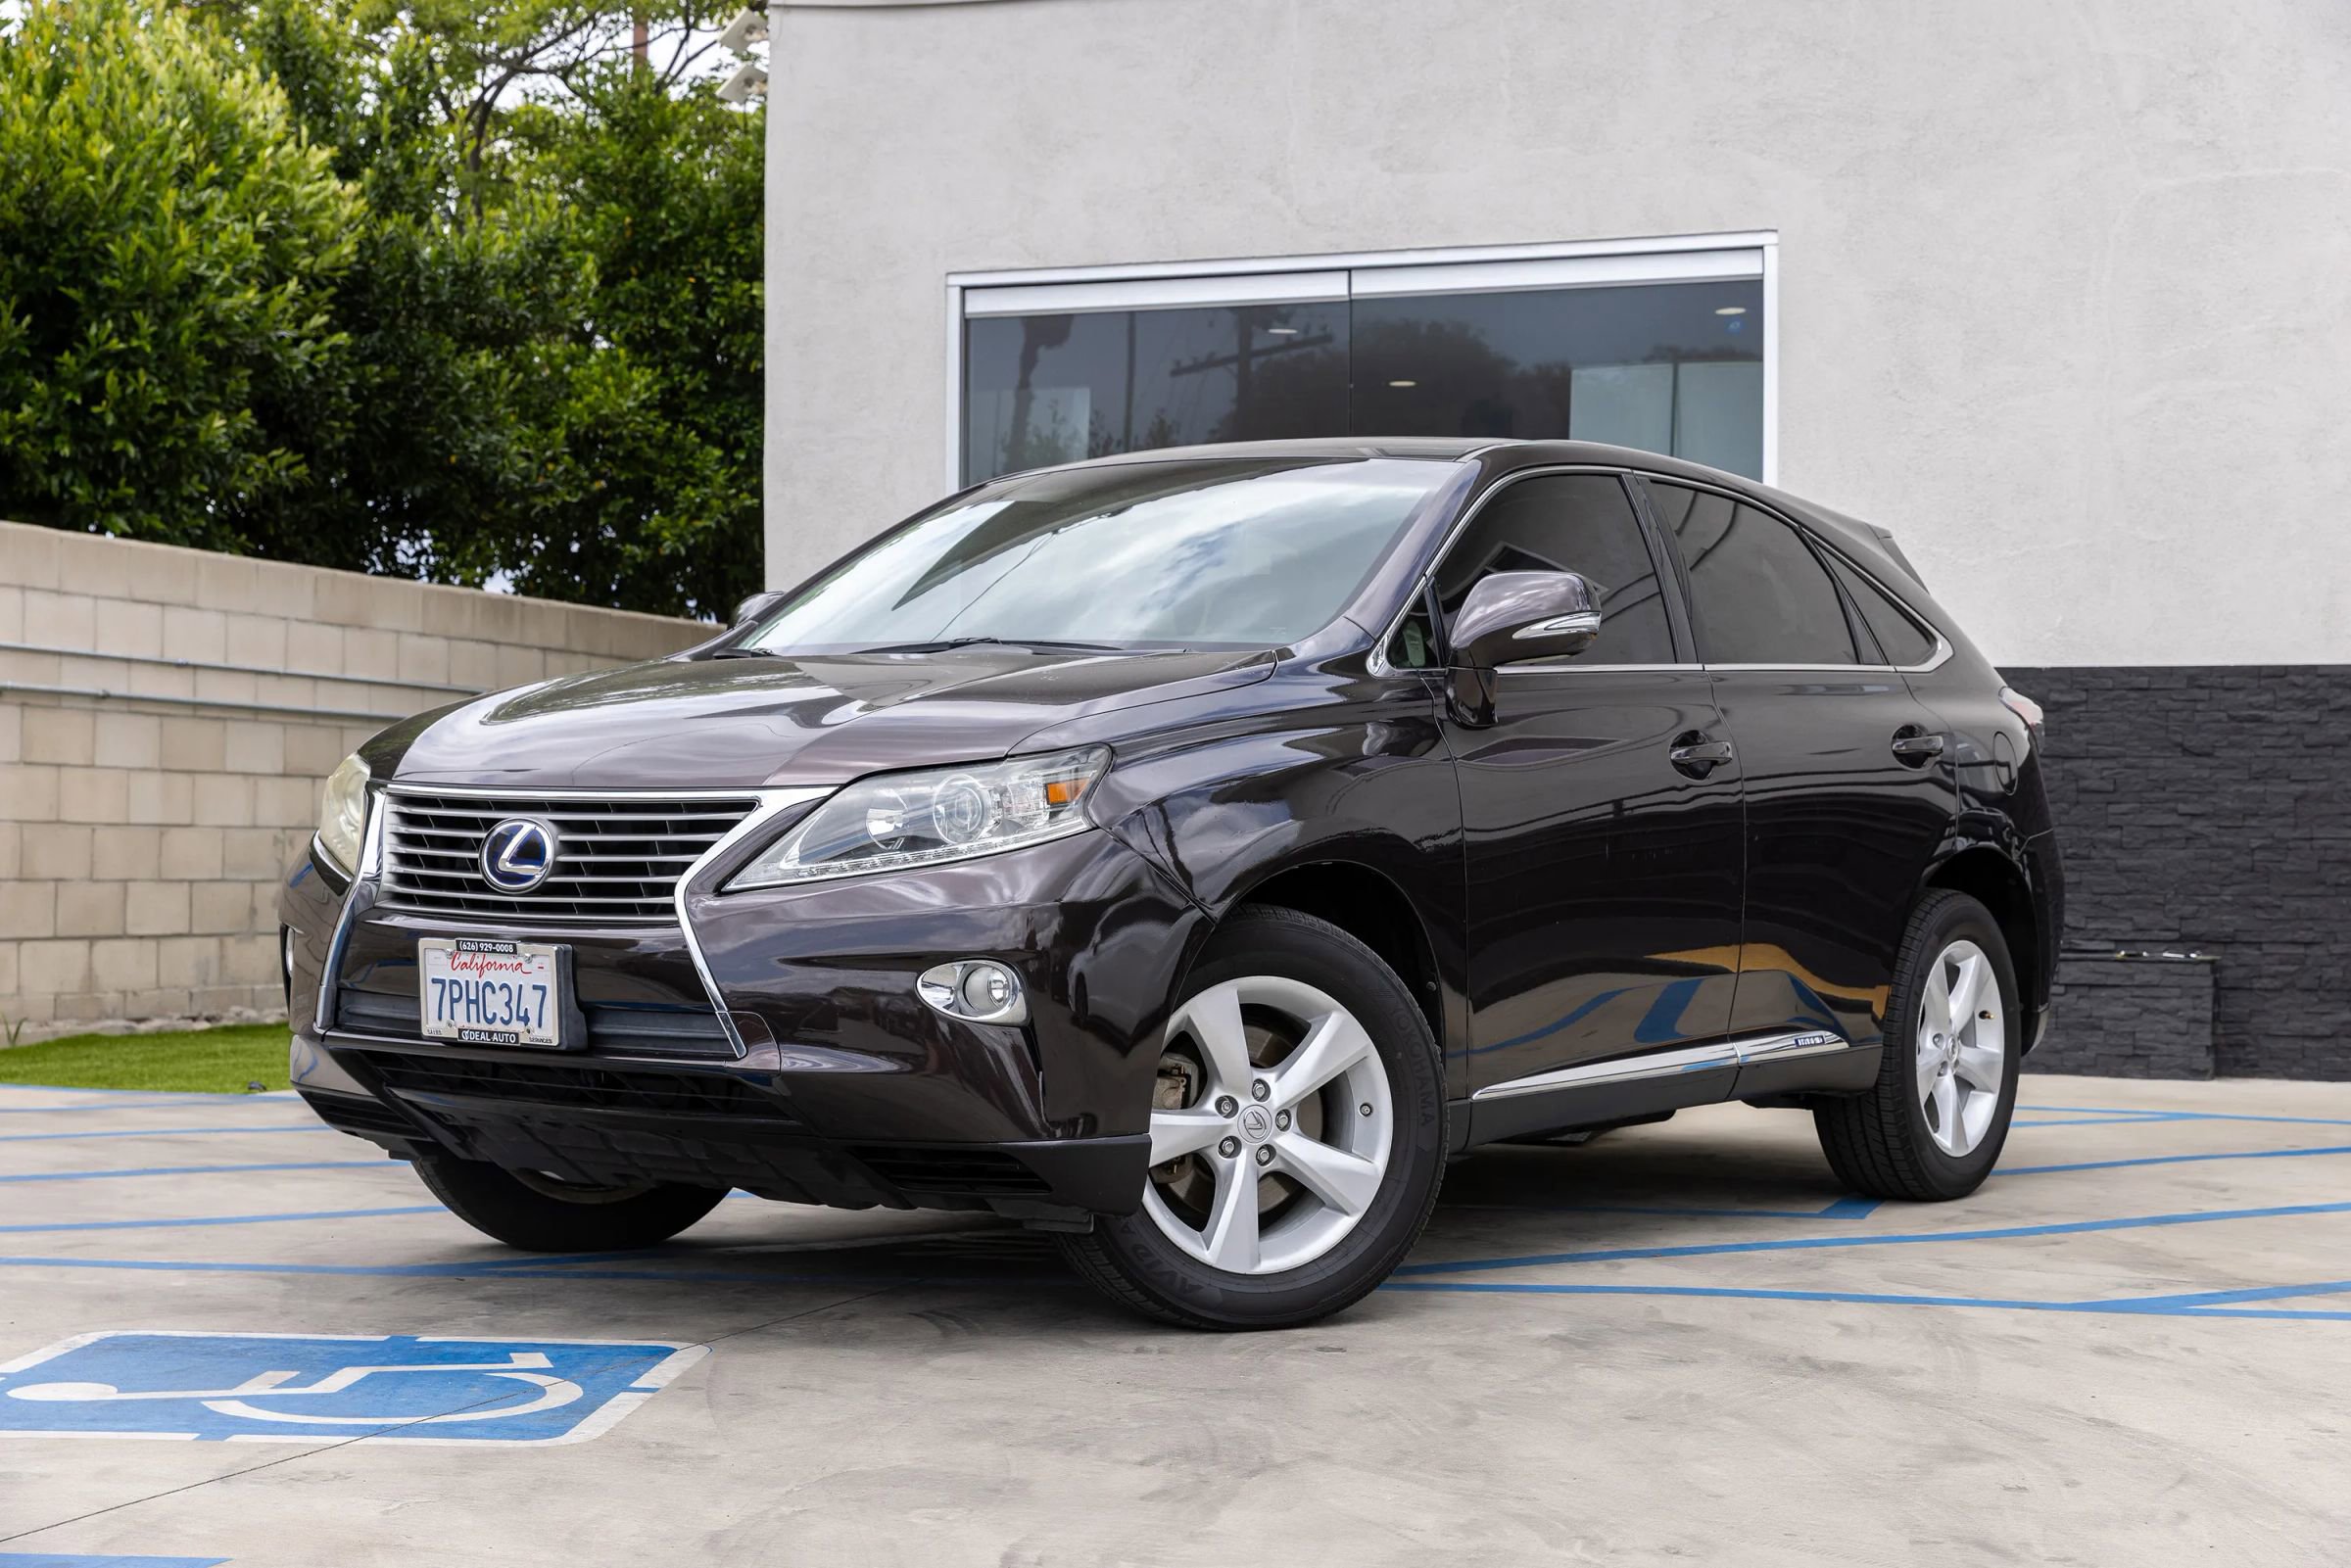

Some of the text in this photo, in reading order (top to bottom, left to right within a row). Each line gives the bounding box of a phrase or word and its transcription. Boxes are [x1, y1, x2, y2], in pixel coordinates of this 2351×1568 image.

[459, 941, 514, 952] (626) 929-0008
[451, 951, 532, 978] California
[431, 977, 547, 1028] 7PHC347
[492, 1033, 516, 1043] AUTO
[1391, 1003, 1434, 1128] YOKOHAMA
